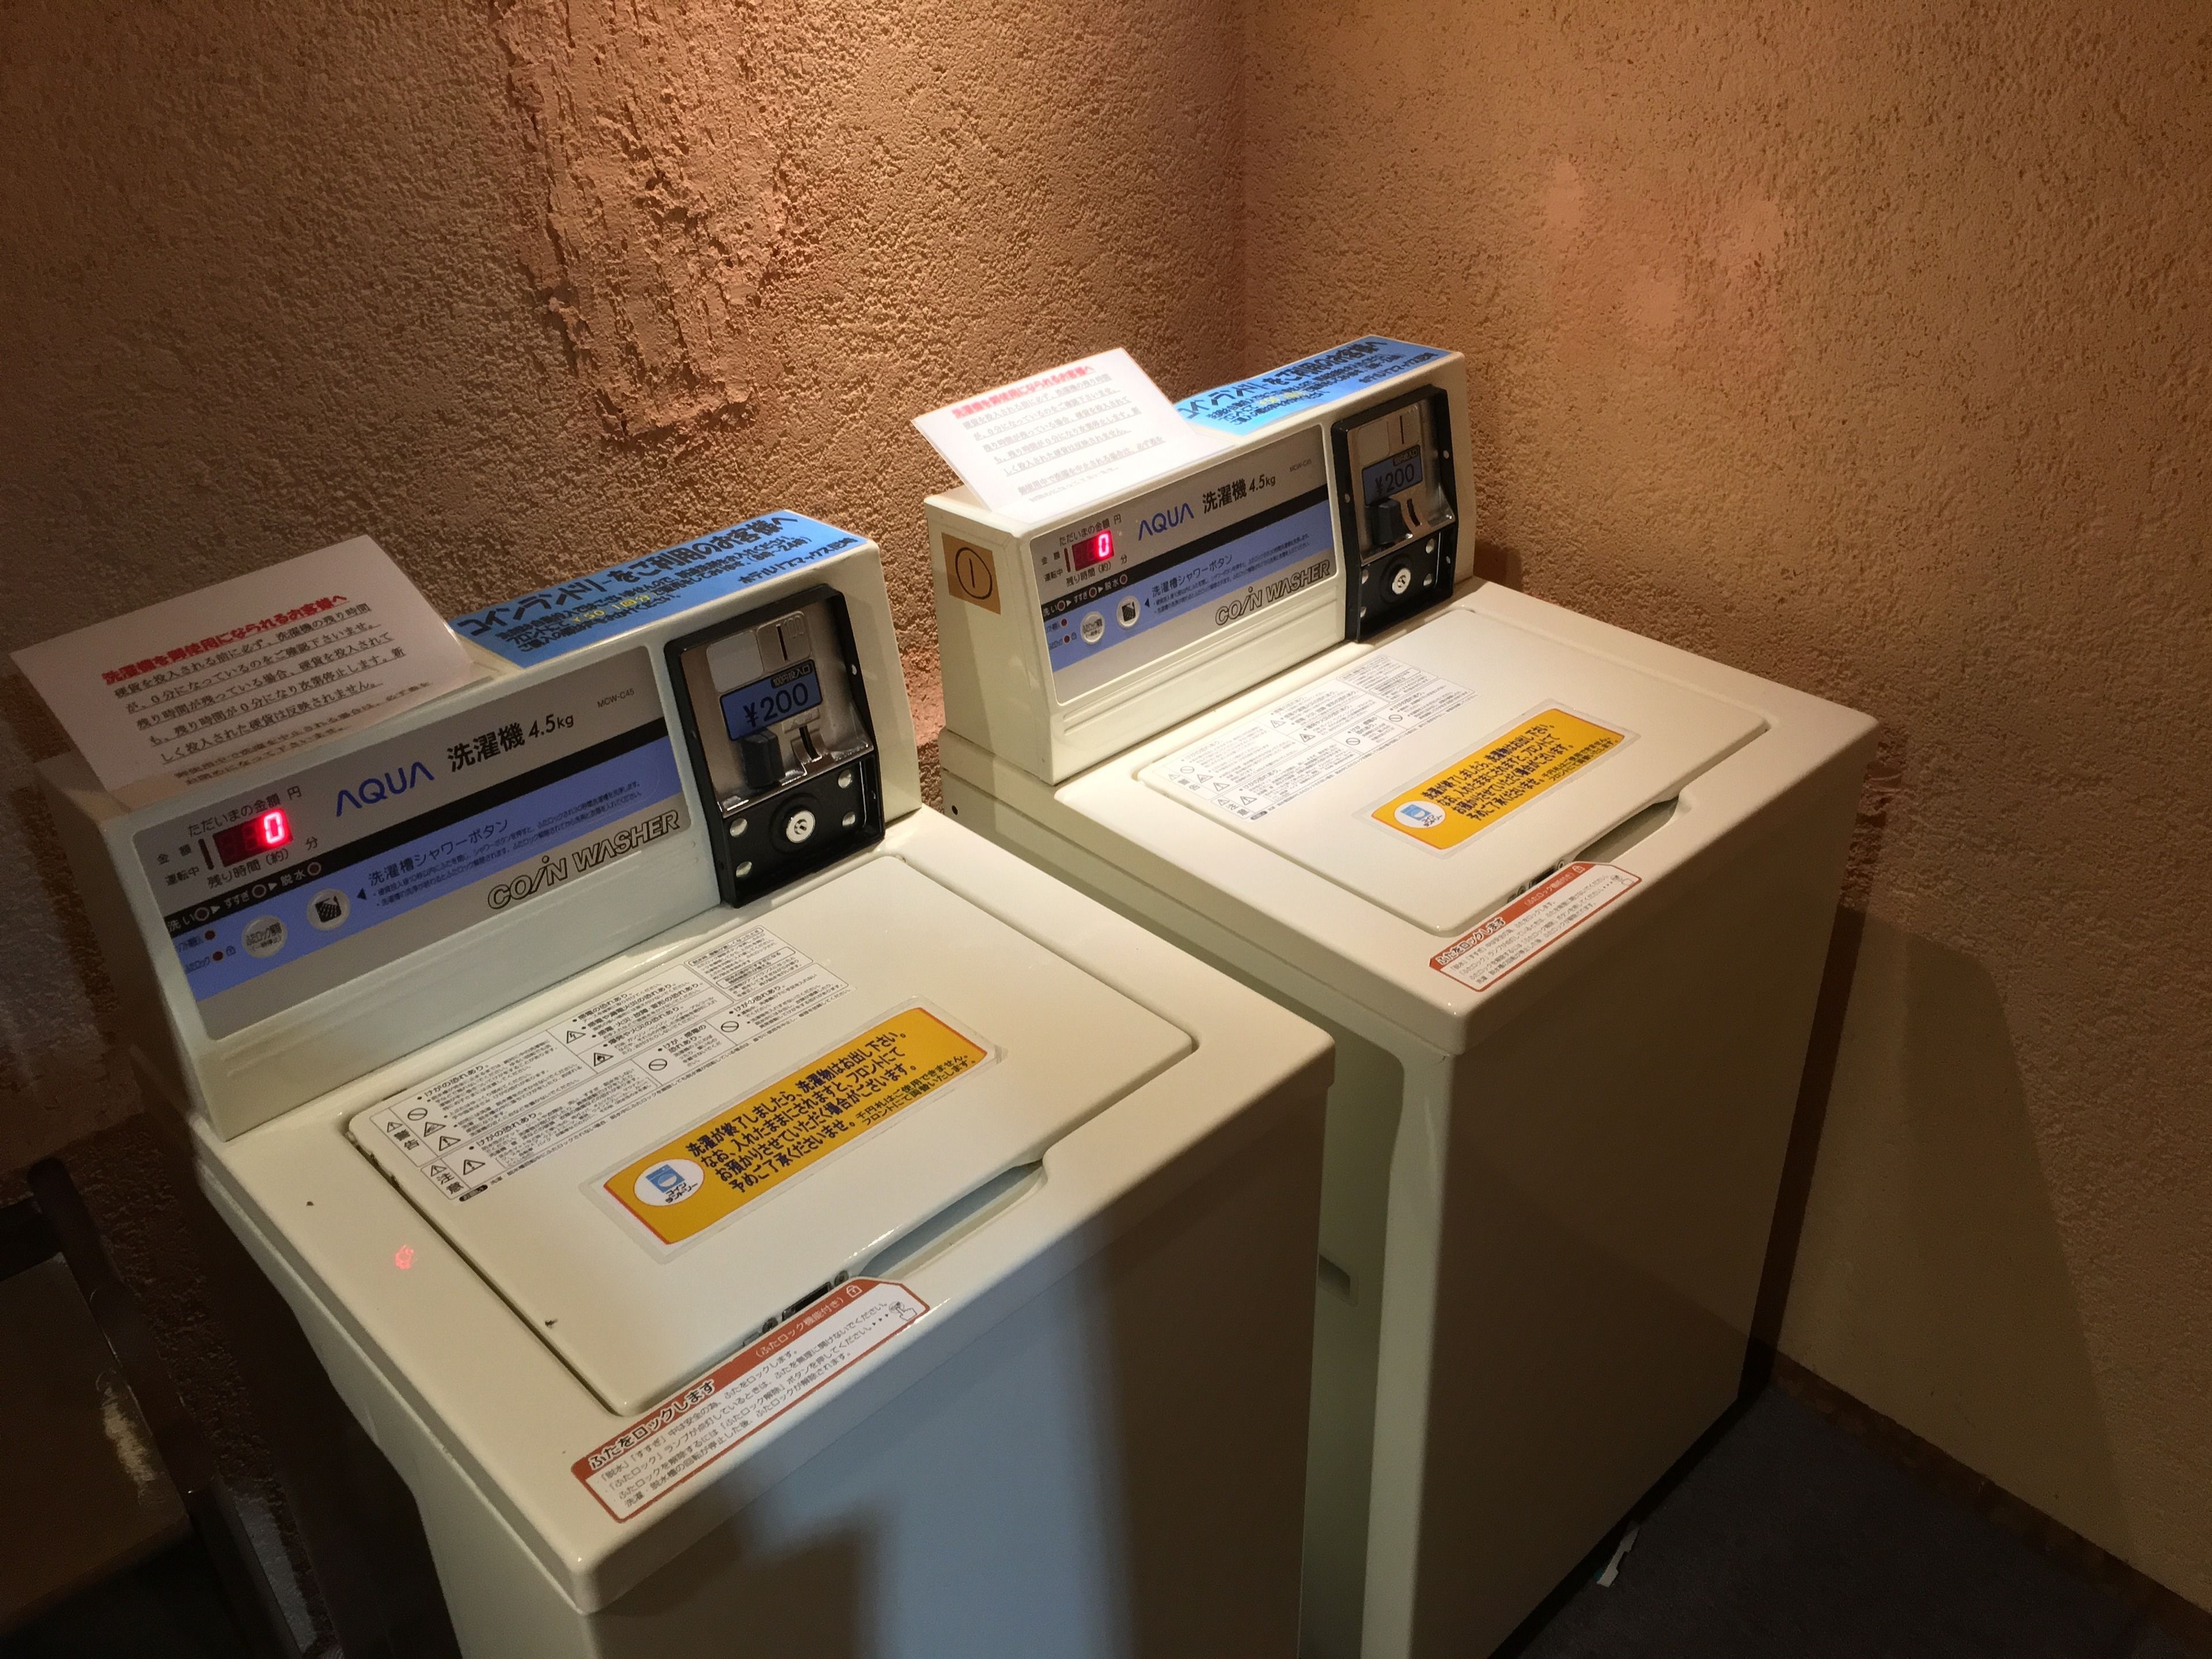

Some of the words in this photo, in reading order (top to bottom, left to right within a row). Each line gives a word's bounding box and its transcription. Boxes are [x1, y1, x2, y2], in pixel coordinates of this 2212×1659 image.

[1202, 477, 1247, 514] 洗濯機
[1248, 469, 1277, 495] 4.5kg
[1113, 513, 1122, 525] 円
[1136, 500, 1194, 541] AQUA
[1096, 532, 1111, 558] 0
[1119, 553, 1127, 565] 分
[1152, 552, 1233, 598] 洗濯槽シャワーボタン
[1213, 581, 1264, 628] COIN
[1265, 556, 1331, 604] WASHER
[743, 682, 809, 728] ¥200
[445, 721, 526, 773] 洗濯機
[525, 707, 576, 743] 4.5kg
[286, 784, 302, 800] 円
[329, 756, 435, 817] AQUA
[260, 810, 288, 845] 0
[304, 835, 319, 851] 分
[367, 817, 510, 887] 洗濯槽シャワーボタン
[483, 849, 570, 912] COIN
[571, 806, 681, 872] WASHER
[435, 1171, 465, 1195] 注意
[586, 1378, 720, 1470] ふたをロックします
